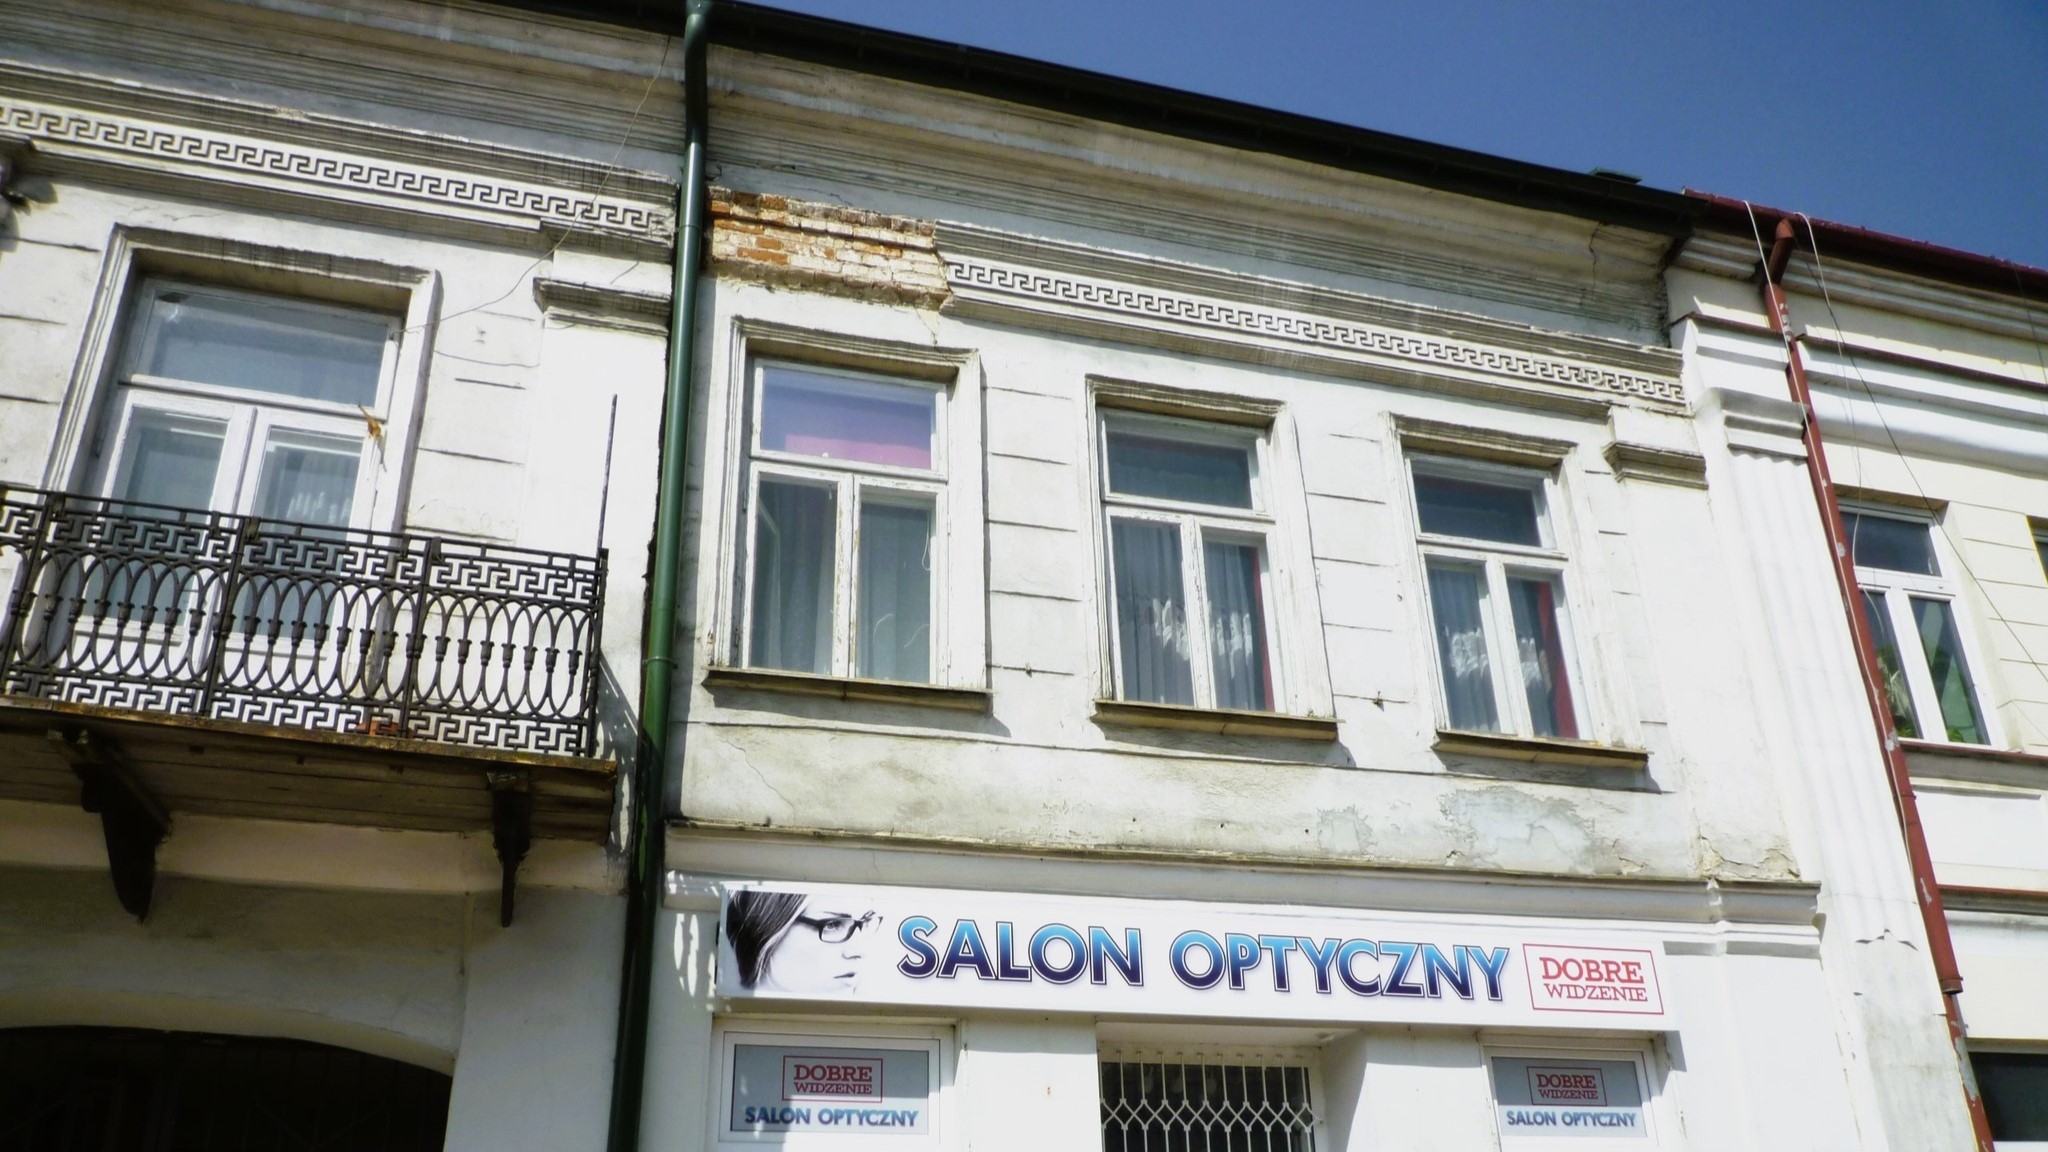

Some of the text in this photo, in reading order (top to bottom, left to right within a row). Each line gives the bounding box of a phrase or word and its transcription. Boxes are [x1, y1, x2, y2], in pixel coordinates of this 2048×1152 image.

[897, 914, 1510, 1001] SALON OPTYCZNY
[1539, 957, 1644, 984] DOBRE
[1544, 983, 1648, 1002] WIDZENIE
[793, 1064, 873, 1082] DOBRE
[1536, 1073, 1597, 1089] DOBRE
[794, 1082, 873, 1095] WIDZENIE
[1538, 1089, 1599, 1100] WIDZENIE
[745, 1106, 919, 1127] SALON OPTYCZNY
[1506, 1110, 1636, 1128] SALON OPTYCZNY
